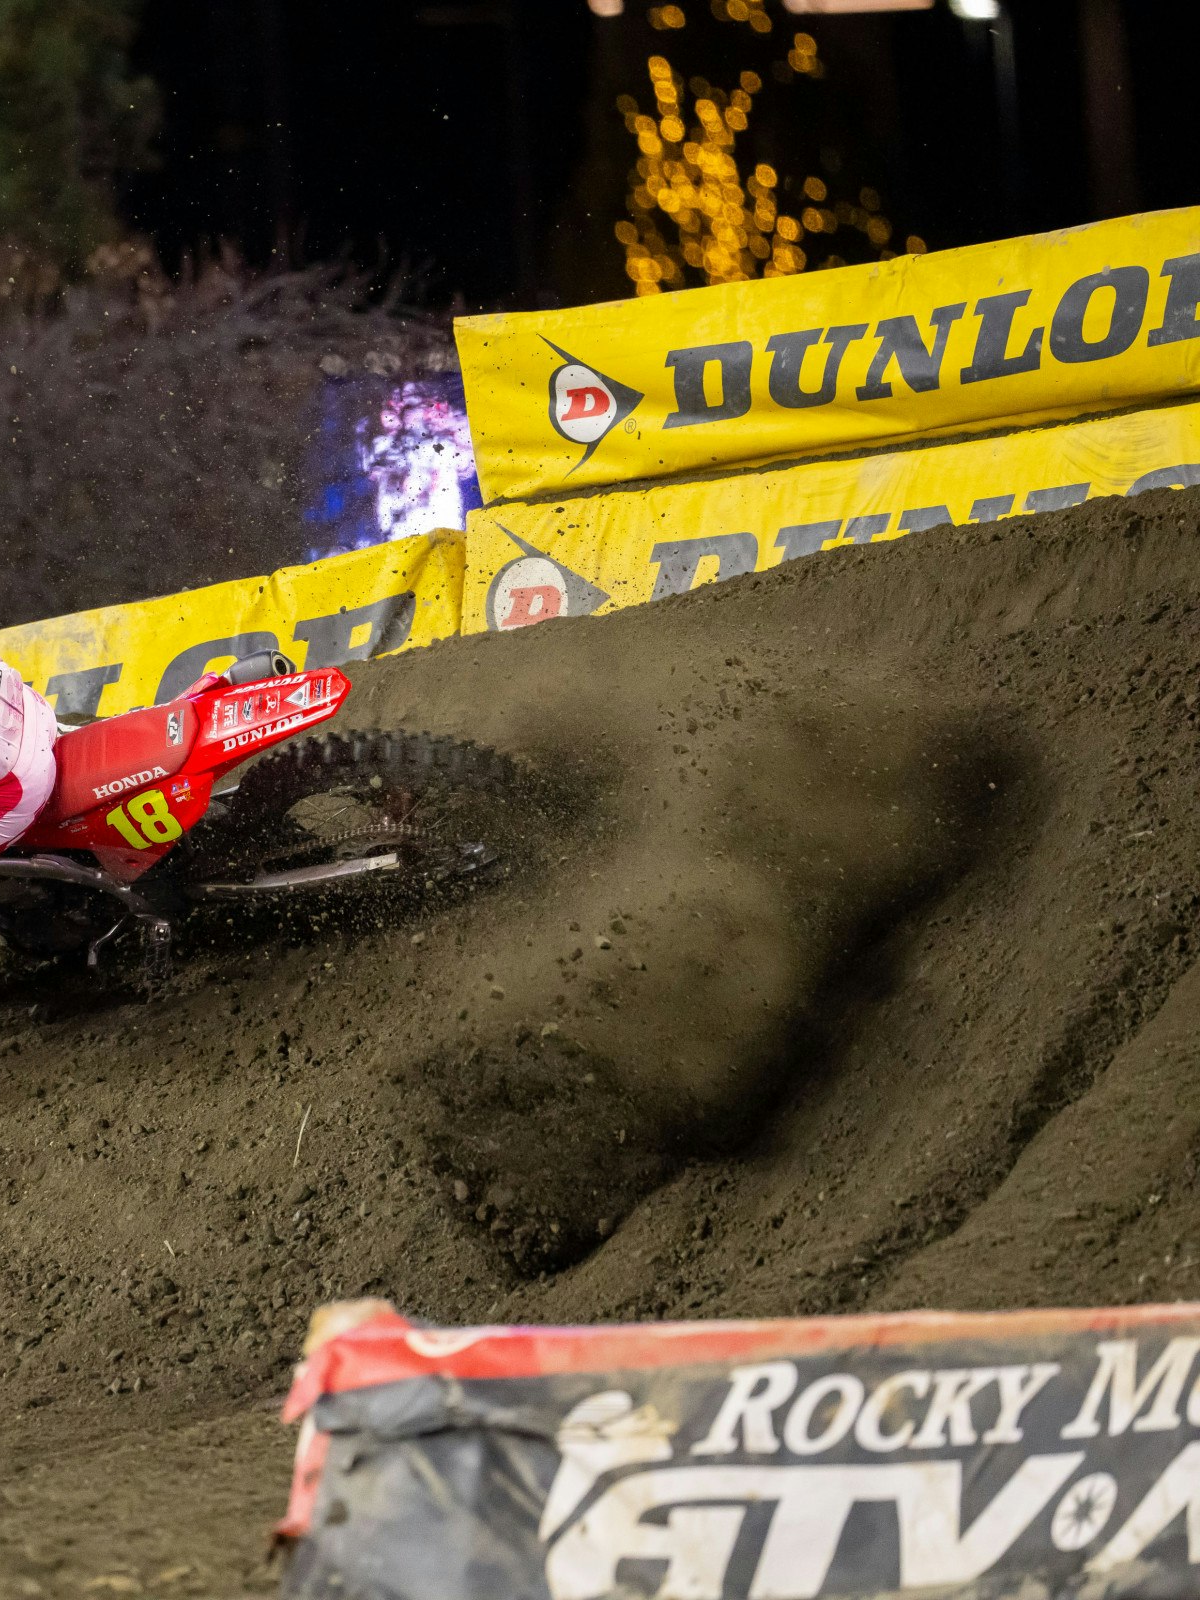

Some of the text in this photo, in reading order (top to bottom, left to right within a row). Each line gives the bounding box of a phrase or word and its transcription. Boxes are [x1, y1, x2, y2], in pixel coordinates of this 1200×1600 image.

[222, 712, 305, 753] DUNLOP
[91, 765, 170, 800] HONDA
[106, 789, 183, 850] 18
[691, 1336, 1200, 1457] ROCKY M
